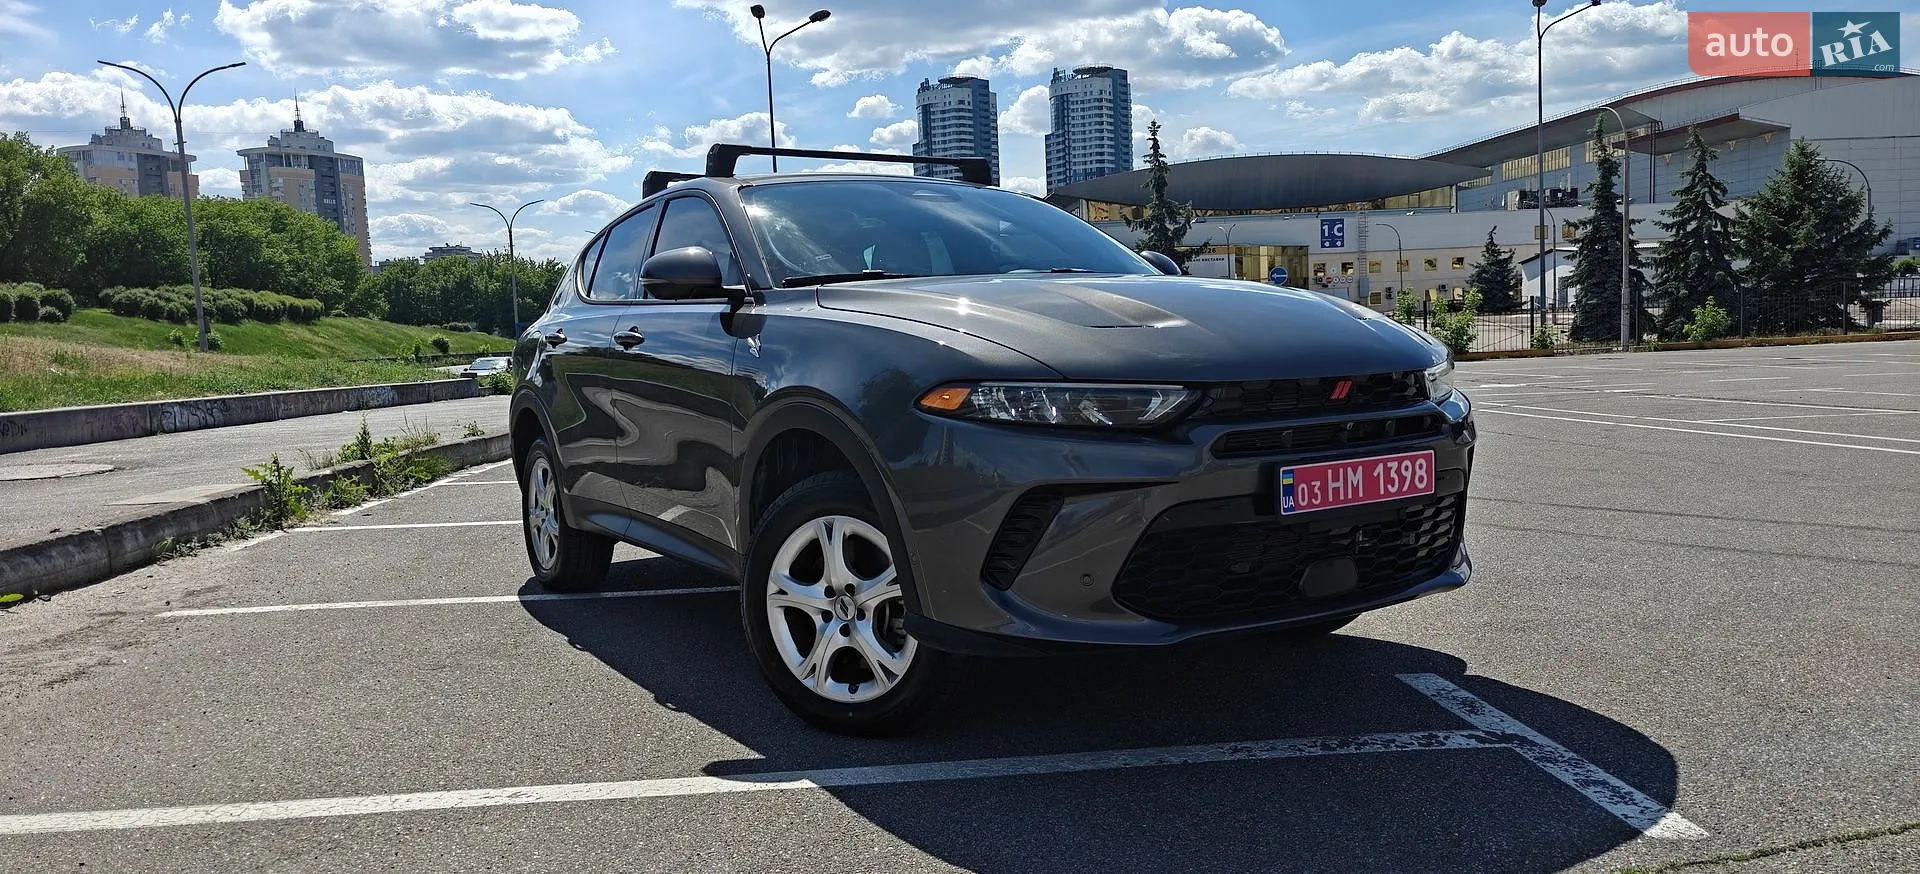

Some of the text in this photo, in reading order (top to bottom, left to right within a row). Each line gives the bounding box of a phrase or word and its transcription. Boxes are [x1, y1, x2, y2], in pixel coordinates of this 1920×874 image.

[1297, 457, 1428, 507] 03 HM 1398
[1282, 496, 1295, 509] UA
